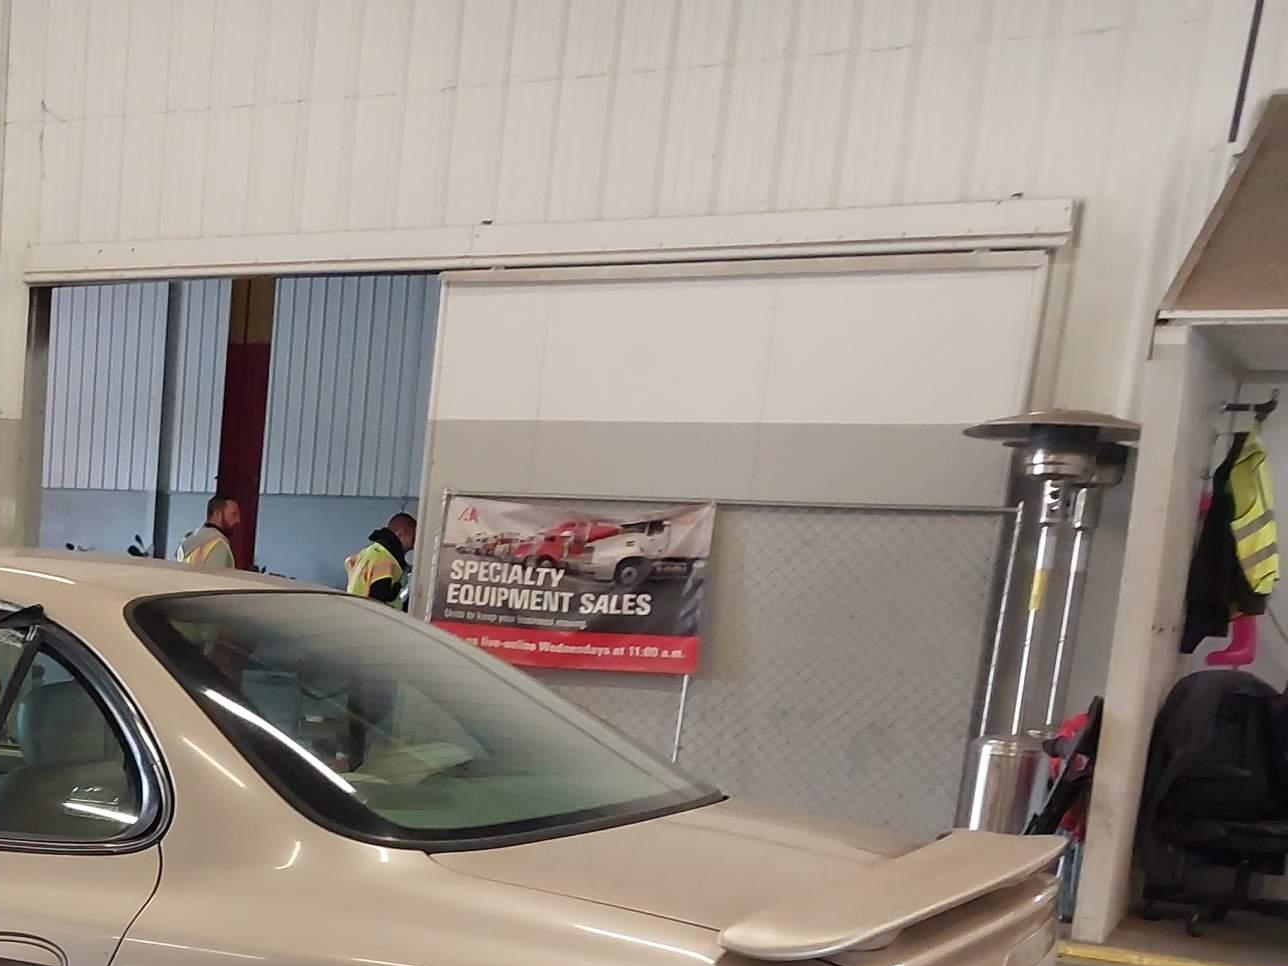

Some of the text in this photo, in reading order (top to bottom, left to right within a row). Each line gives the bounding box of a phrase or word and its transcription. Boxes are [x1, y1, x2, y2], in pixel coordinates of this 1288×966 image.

[450, 559, 565, 588] SPECIALTY
[446, 583, 652, 616] EQUIPMENT SALES
[539, 641, 610, 657] Wednesdays
[612, 646, 625, 656] at
